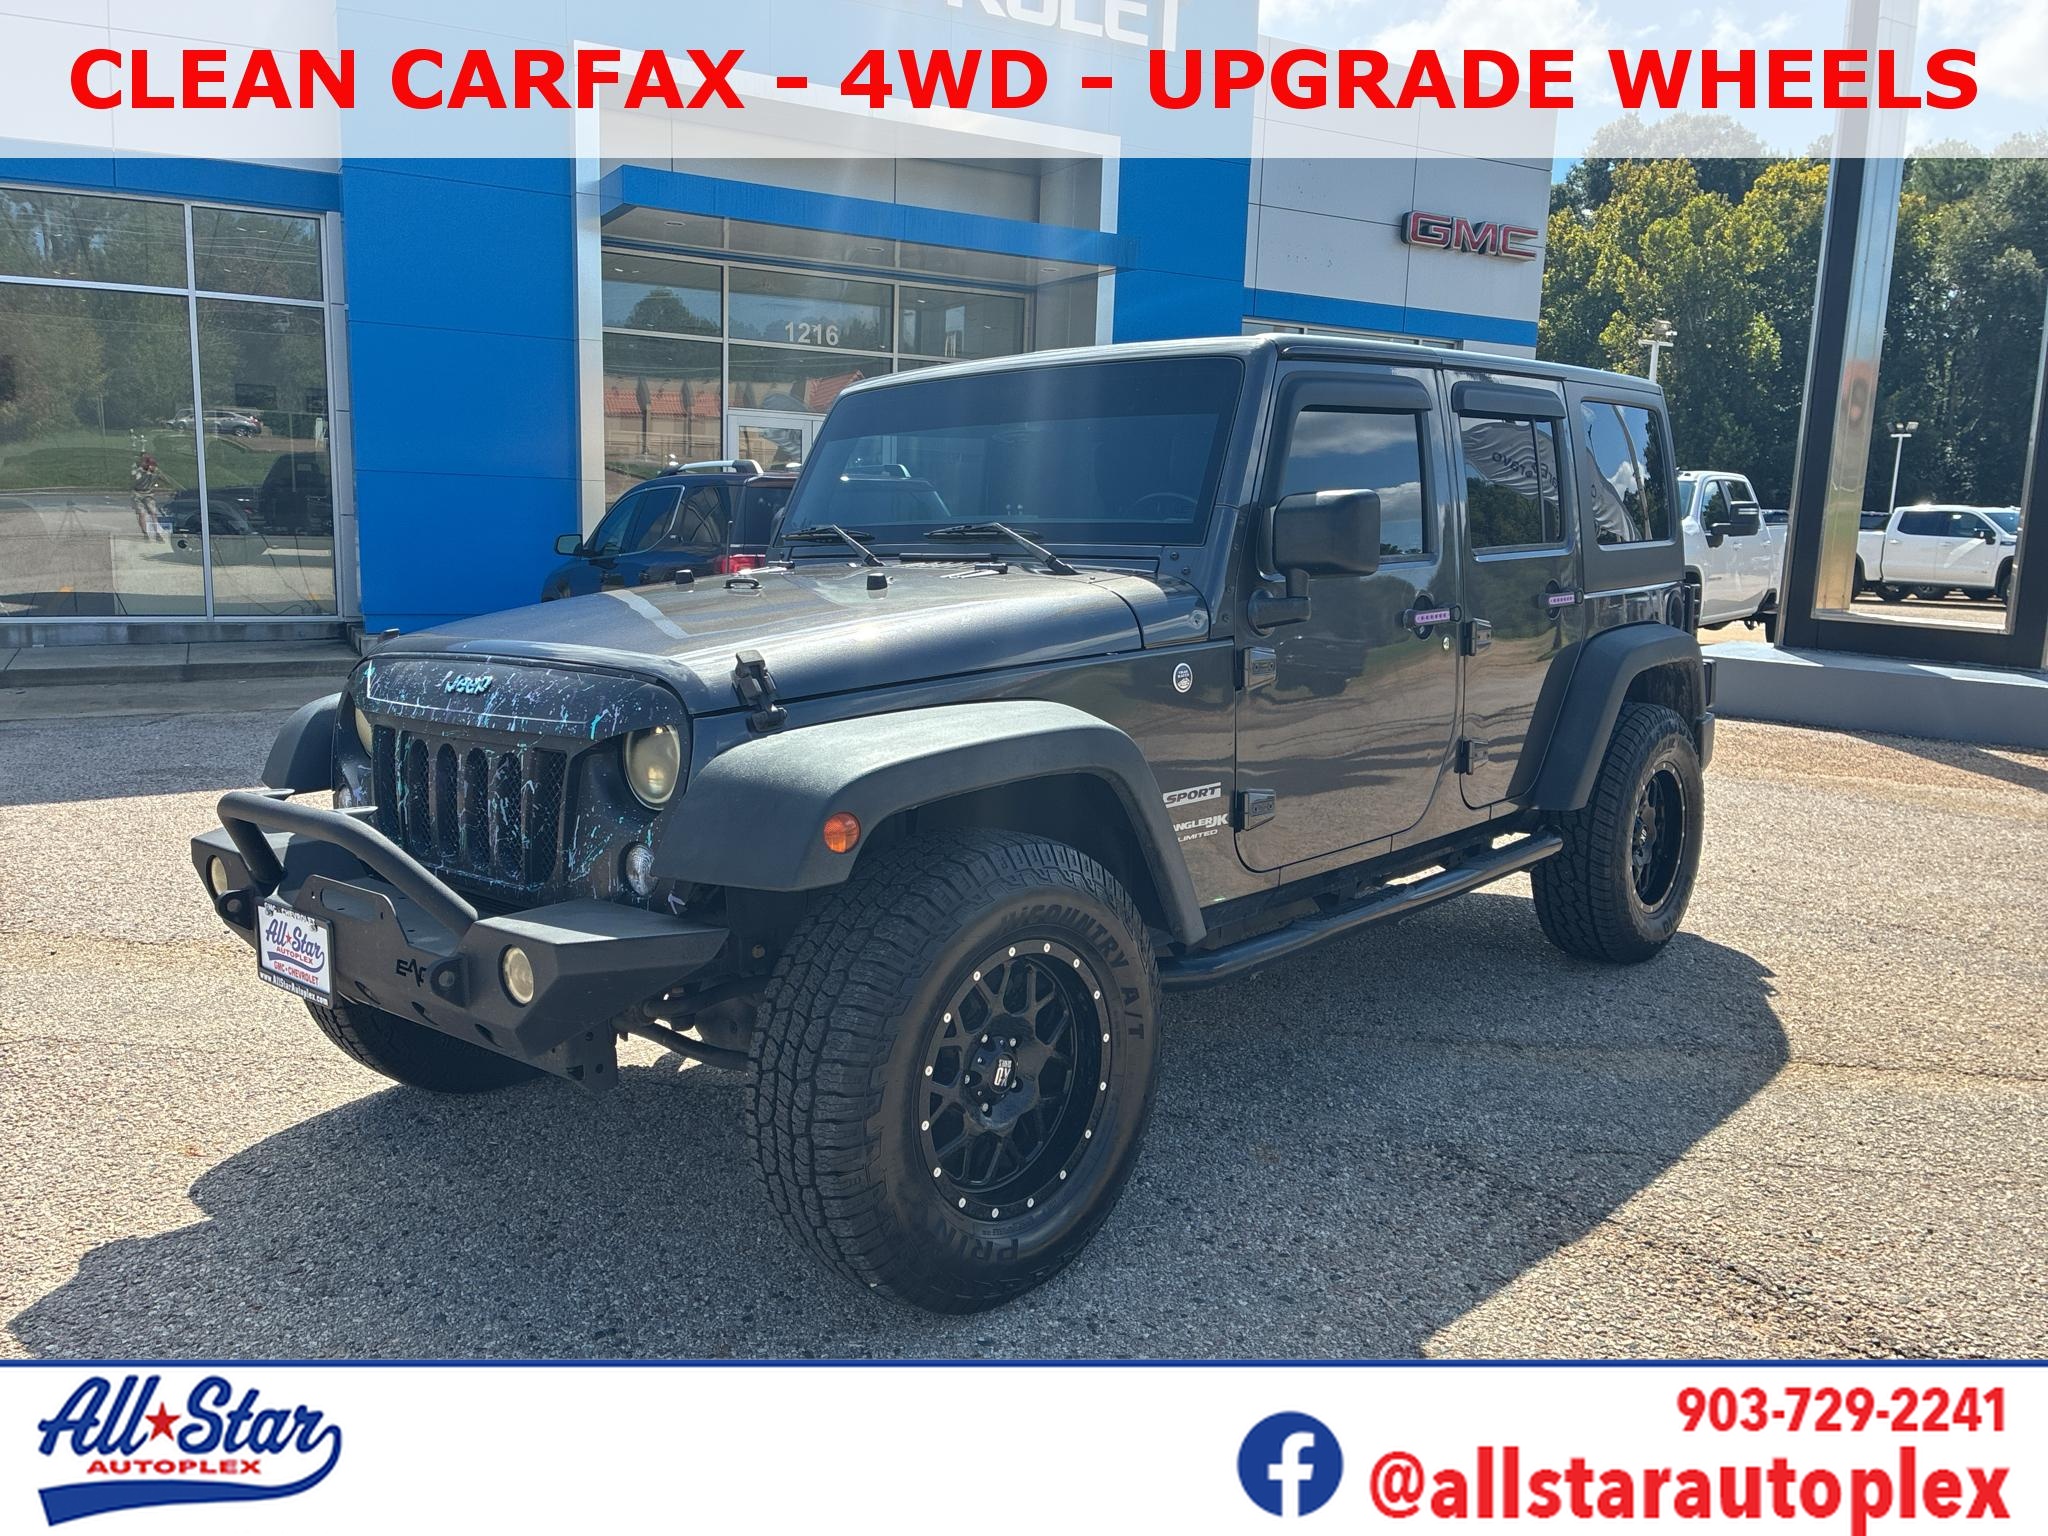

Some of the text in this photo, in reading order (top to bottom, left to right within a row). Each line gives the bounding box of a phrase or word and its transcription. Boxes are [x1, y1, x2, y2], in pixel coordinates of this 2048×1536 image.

[1405, 210, 1538, 260] GMC
[785, 321, 839, 346] 1216
[444, 674, 493, 694] Jeep
[1163, 786, 1221, 805] SPORT
[266, 918, 322, 959] All Star
[276, 946, 313, 965] AUTOPLEX
[1120, 987, 1145, 1039] A/T
